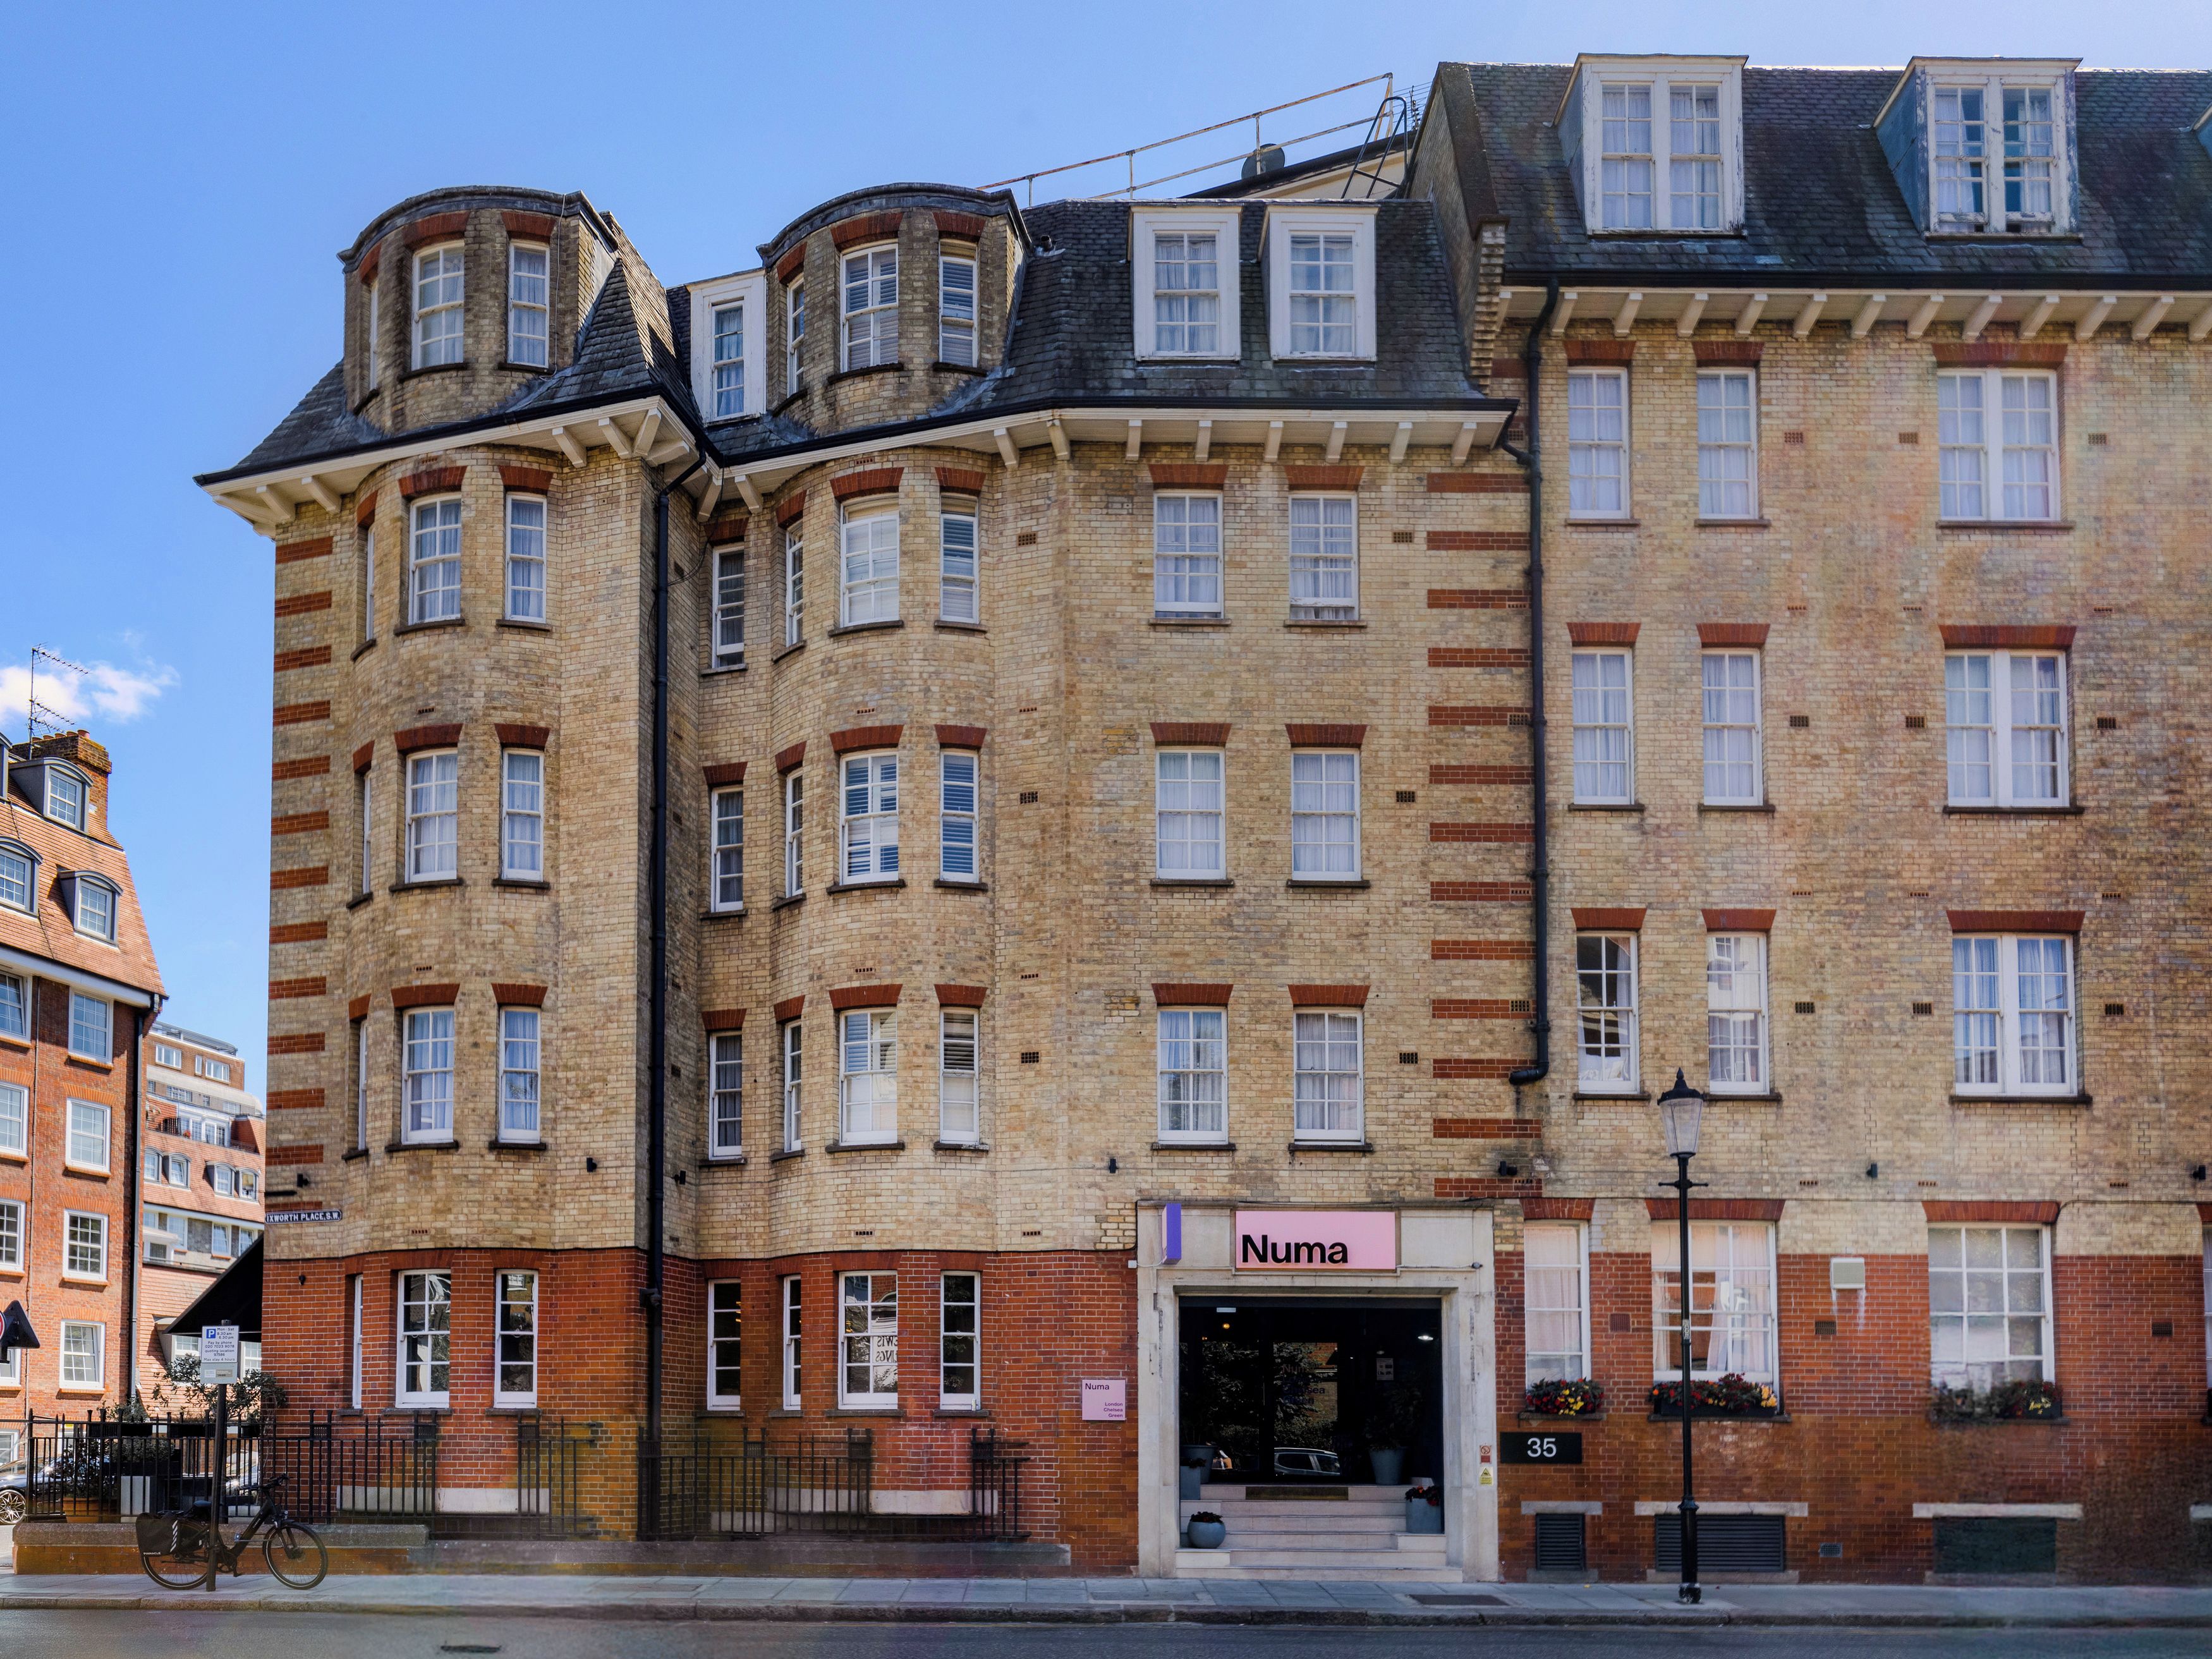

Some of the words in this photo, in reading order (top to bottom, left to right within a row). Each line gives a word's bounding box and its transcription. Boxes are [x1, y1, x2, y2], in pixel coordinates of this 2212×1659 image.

[267, 1213, 298, 1223] IXWORTH
[1242, 1234, 1348, 1264] Numa
[209, 1330, 215, 1338] P
[1283, 1385, 1325, 1394] Chsea
[1527, 1437, 1557, 1457] 35
